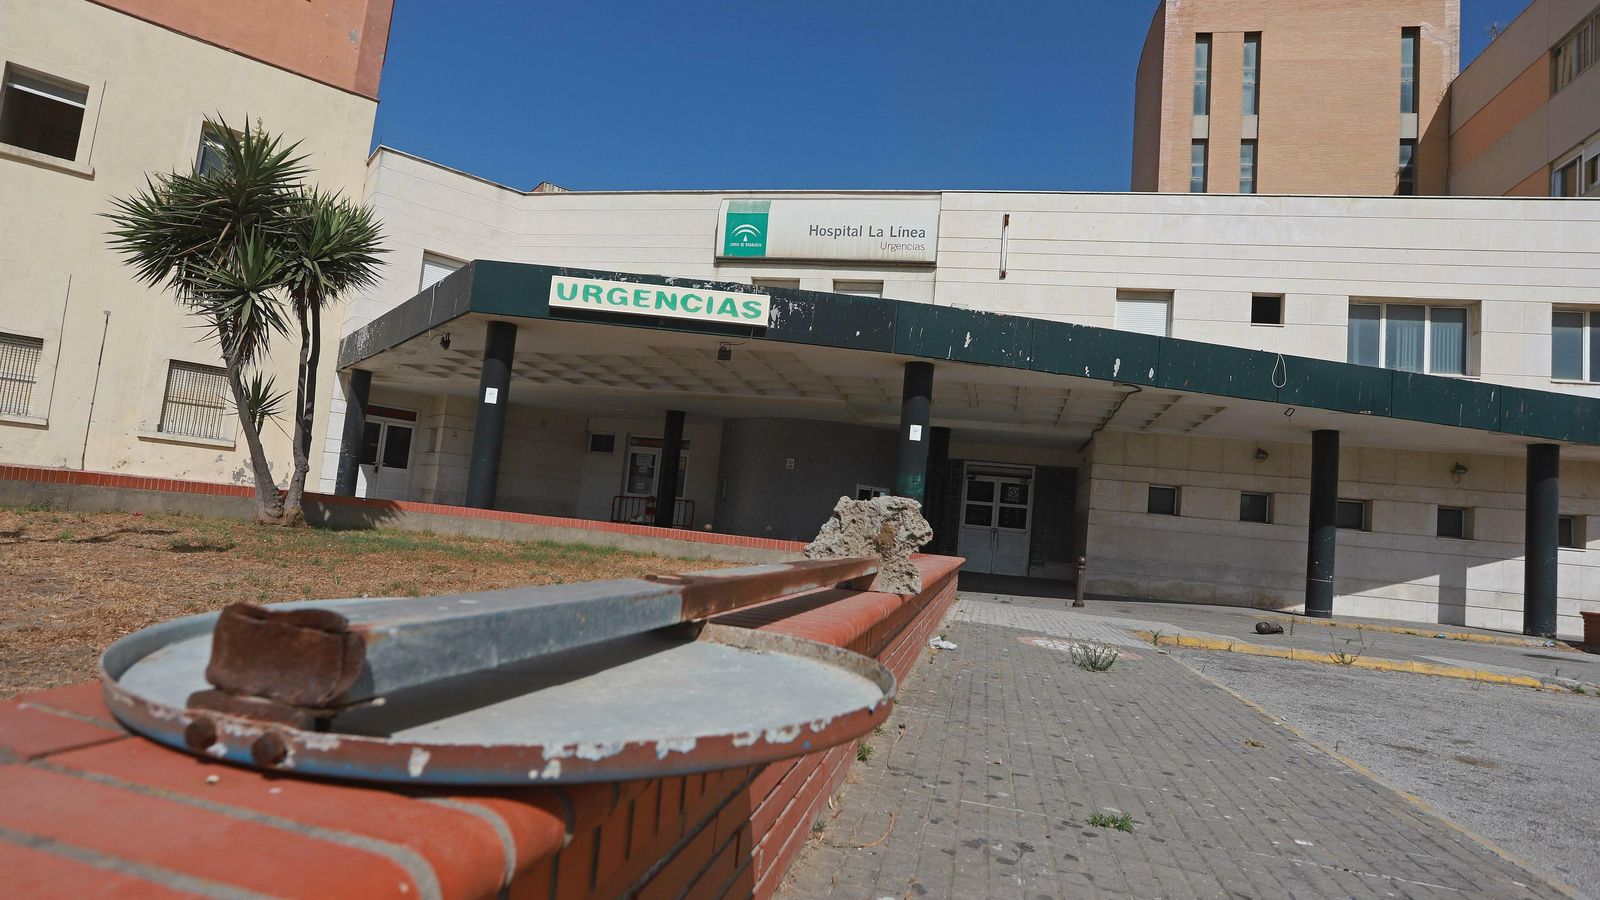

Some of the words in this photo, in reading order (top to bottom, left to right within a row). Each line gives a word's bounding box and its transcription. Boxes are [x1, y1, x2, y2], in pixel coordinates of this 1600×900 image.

[809, 225, 862, 239] Hospital
[869, 226, 884, 238] La
[890, 225, 925, 238] Línea
[880, 241, 926, 252] Urgencias
[556, 282, 762, 319] URGENCIAS
